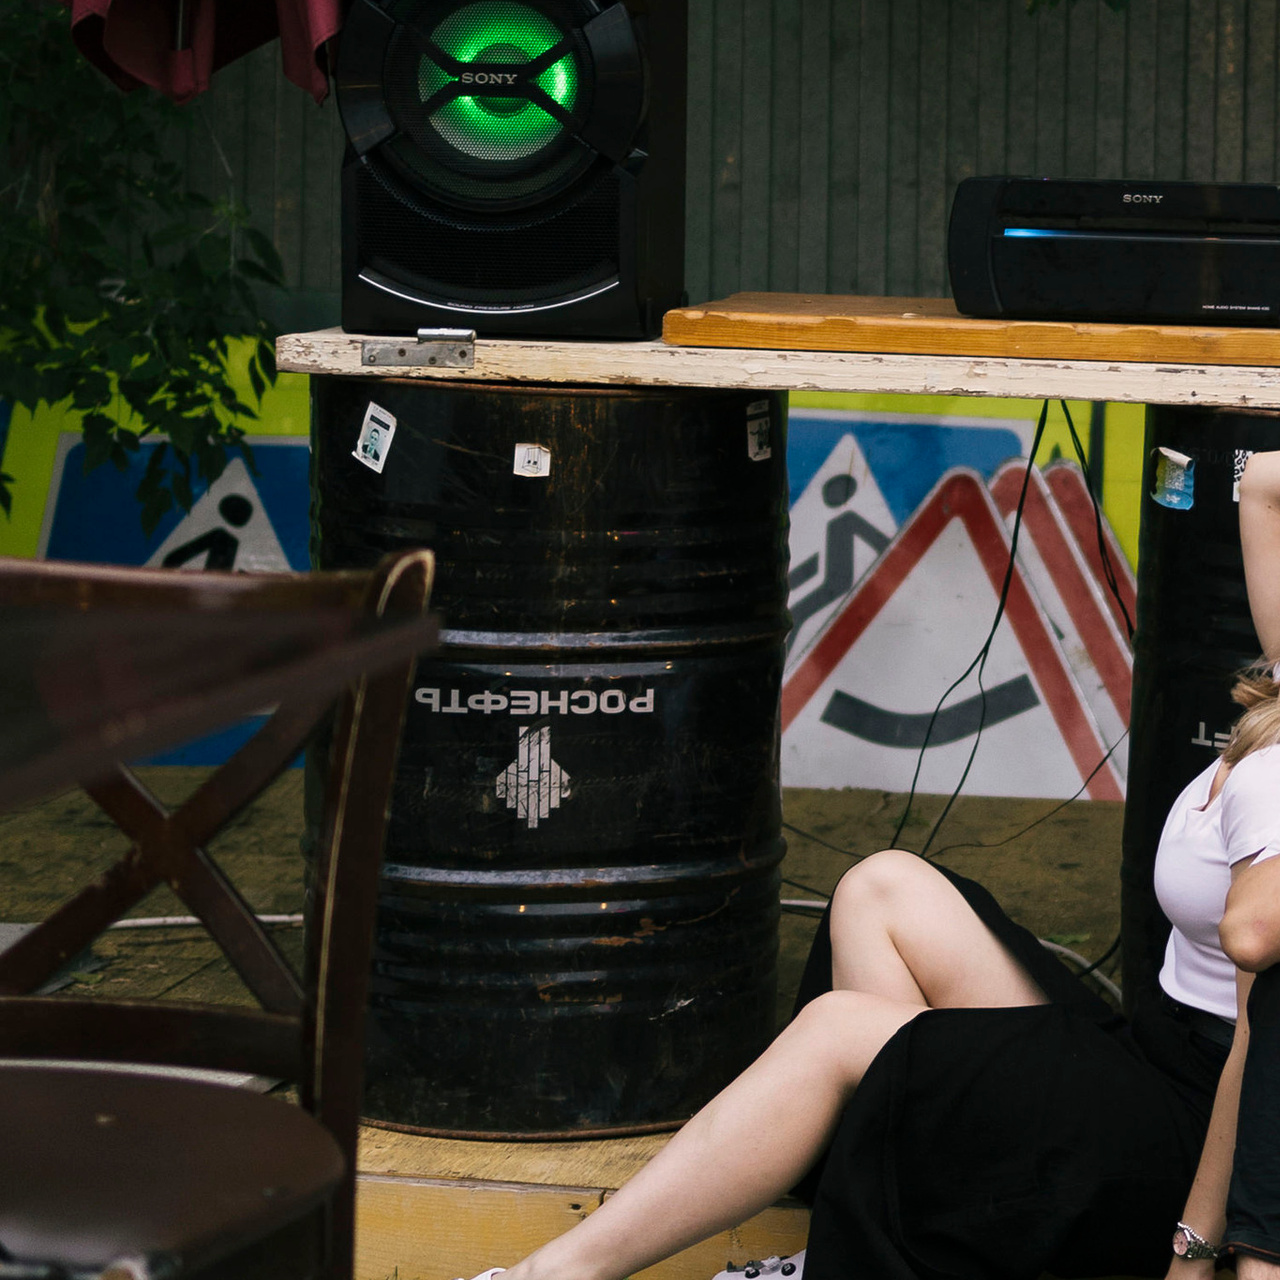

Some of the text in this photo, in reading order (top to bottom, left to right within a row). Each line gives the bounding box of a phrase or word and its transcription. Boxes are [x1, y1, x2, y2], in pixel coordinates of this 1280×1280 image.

[461, 72, 518, 84] SONY
[1122, 194, 1164, 203] SONY
[414, 687, 655, 715] РОСНЕФТЬ
